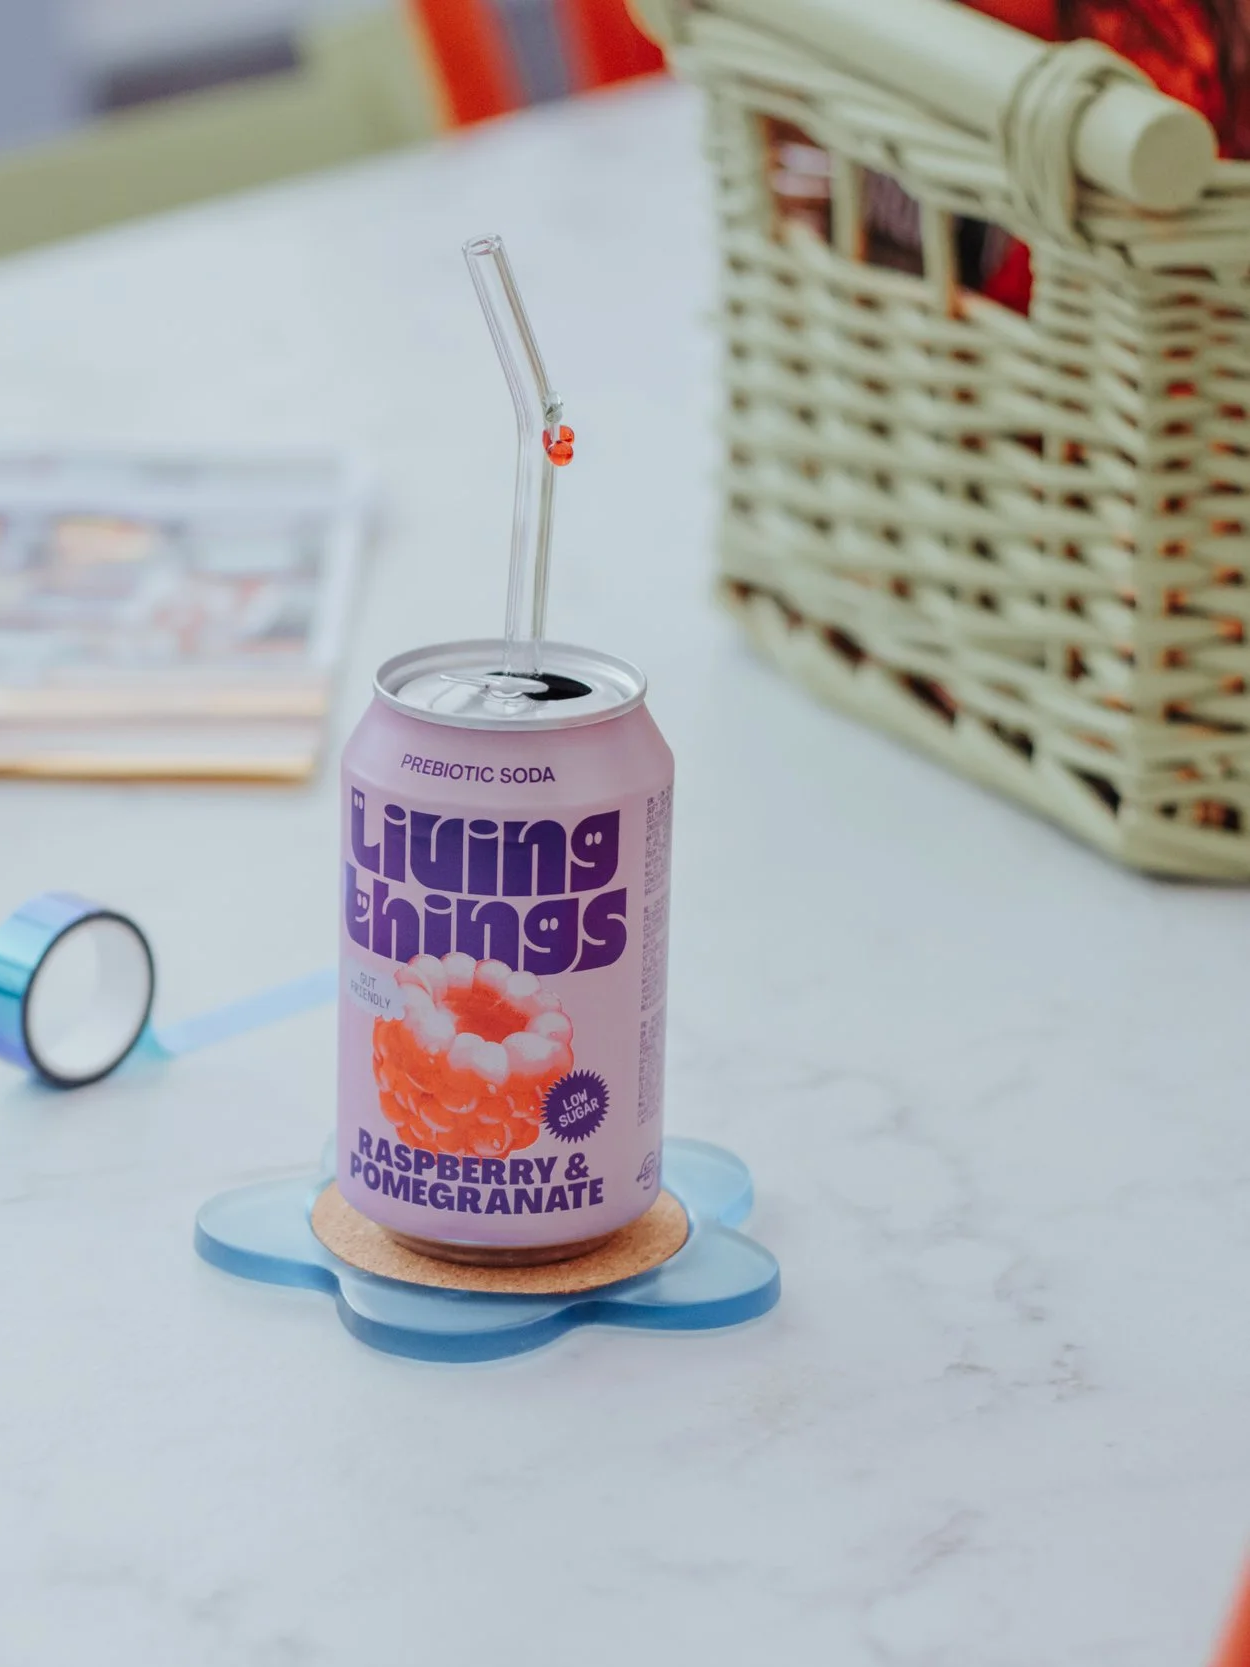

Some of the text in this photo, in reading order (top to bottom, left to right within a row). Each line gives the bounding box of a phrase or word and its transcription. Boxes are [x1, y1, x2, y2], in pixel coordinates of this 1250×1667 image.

[400, 753, 556, 784] PREBIOTIC SODA
[350, 979, 391, 1010] FRIENDLY
[360, 971, 378, 990] GUT
[558, 1097, 600, 1128] SUGAR
[562, 1088, 588, 1111] LOW
[358, 1127, 590, 1186] RASPBERRY &
[350, 1151, 605, 1216] POMEGRANATE
